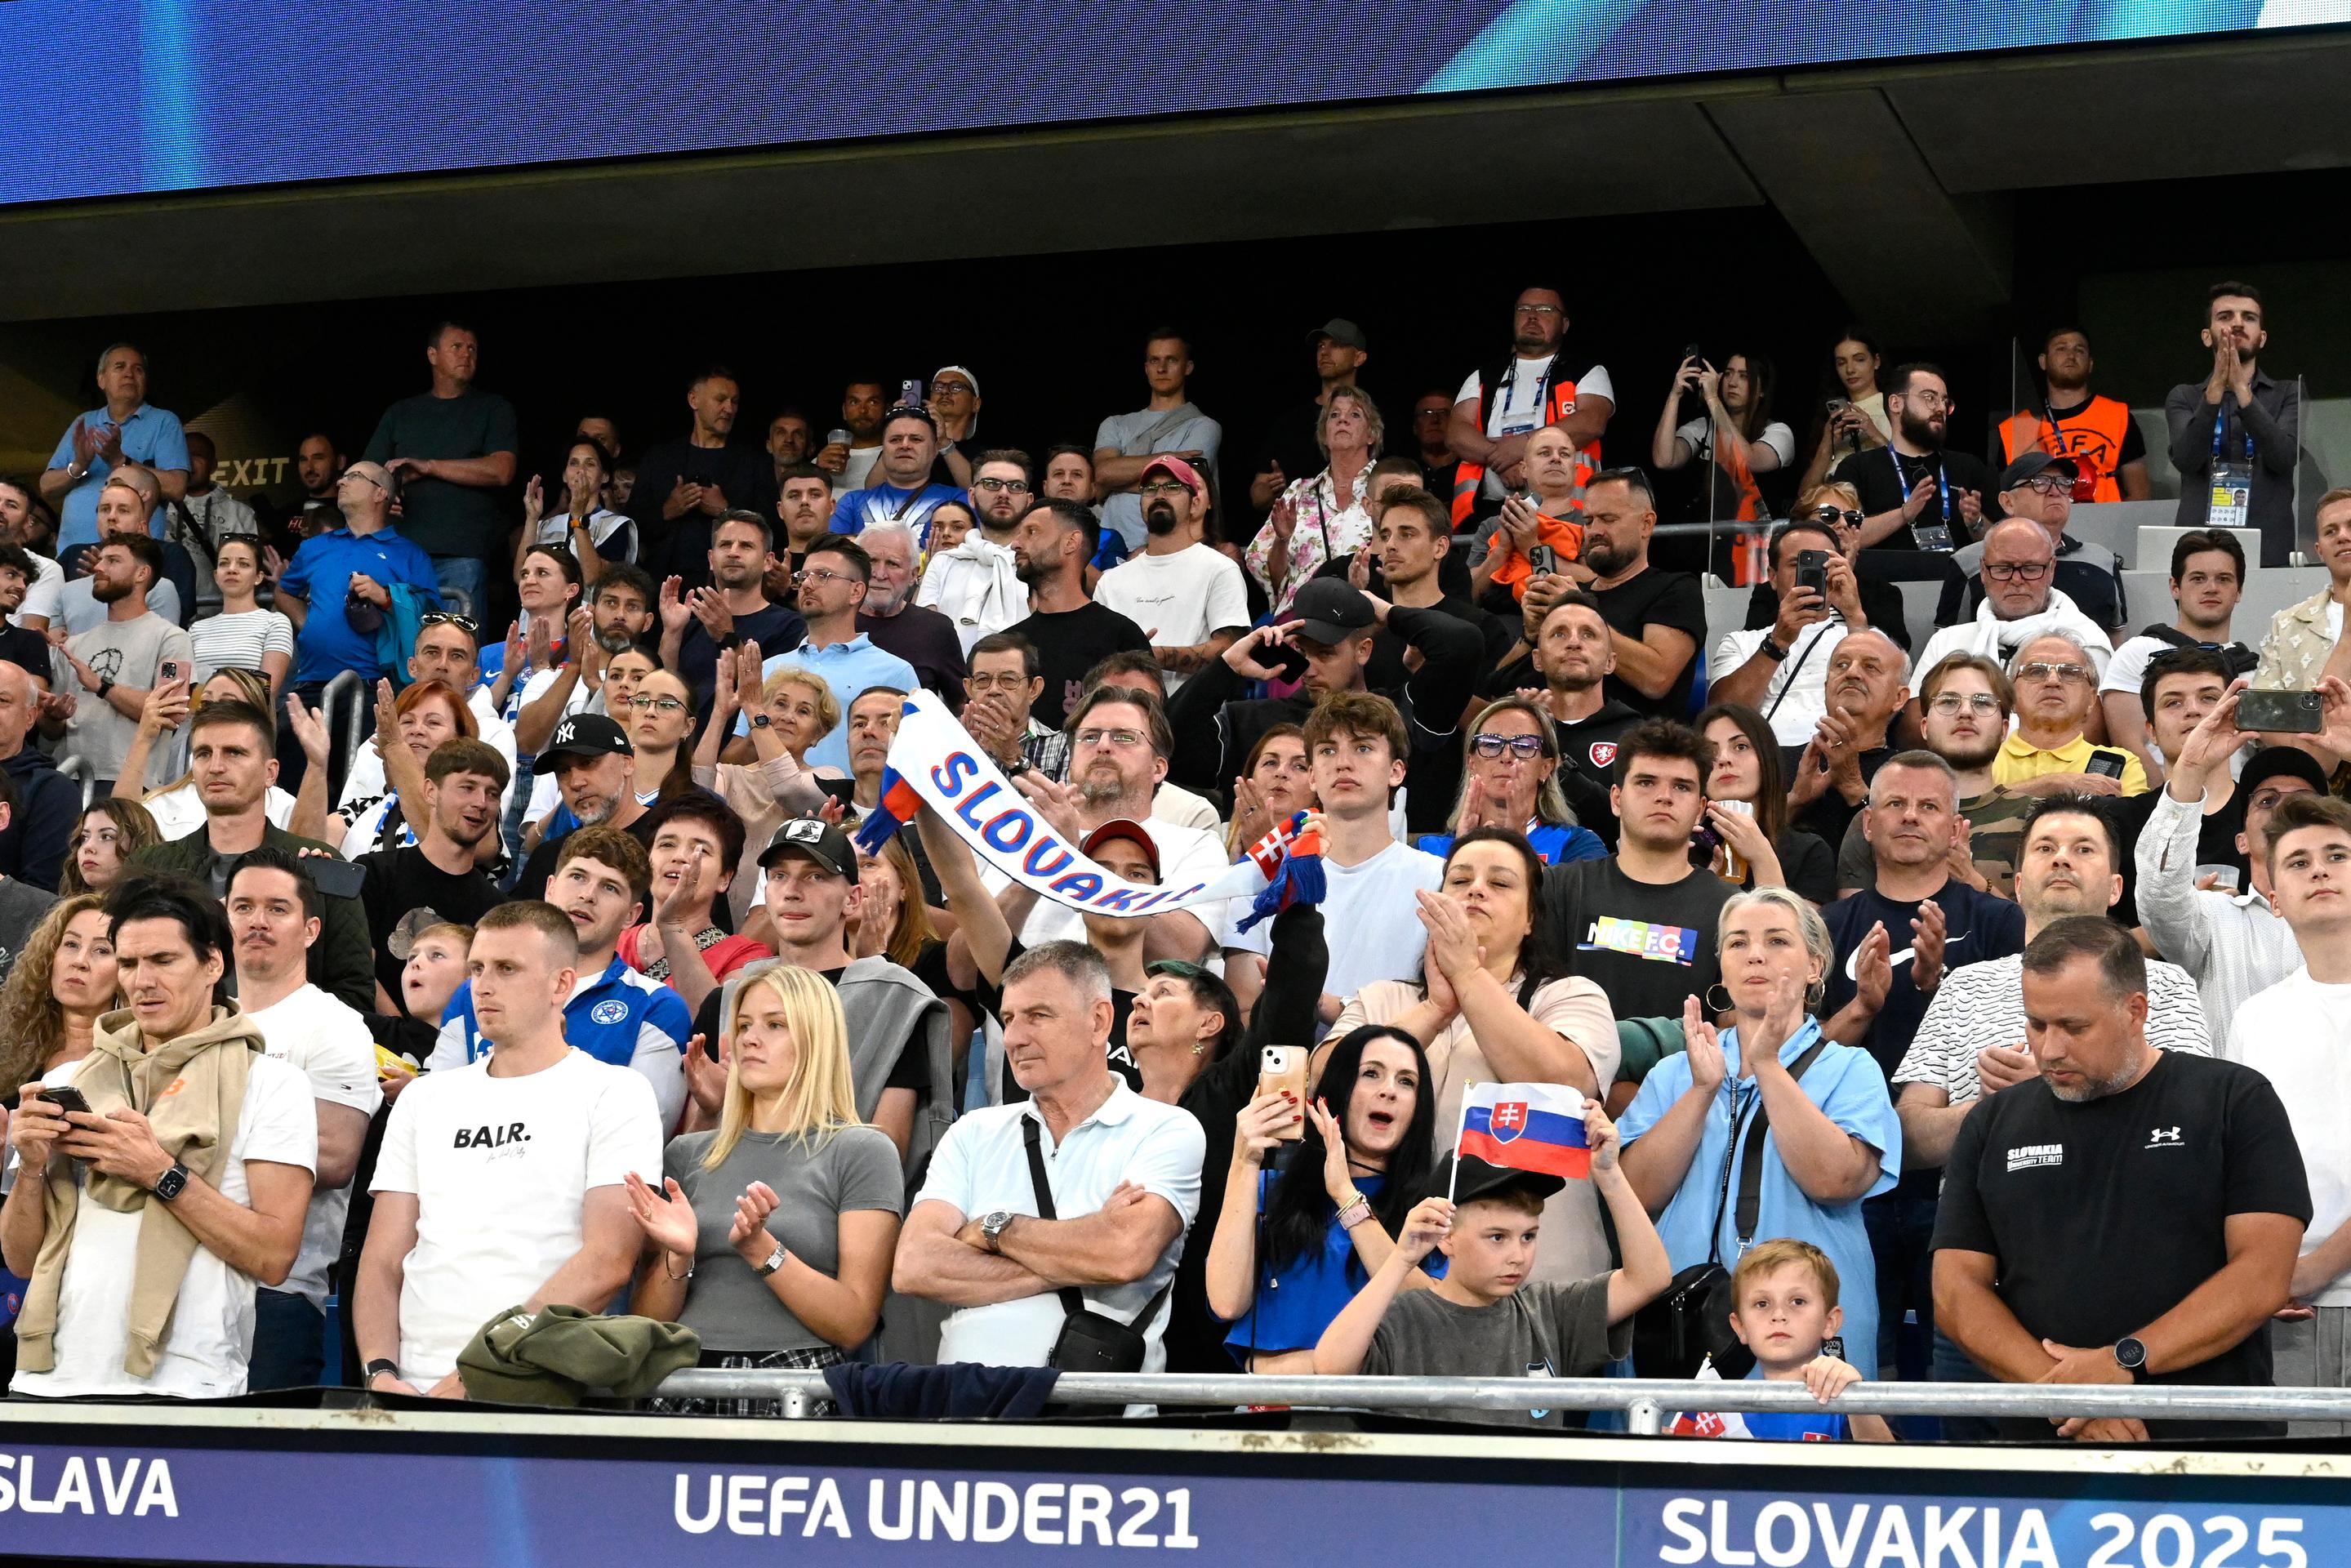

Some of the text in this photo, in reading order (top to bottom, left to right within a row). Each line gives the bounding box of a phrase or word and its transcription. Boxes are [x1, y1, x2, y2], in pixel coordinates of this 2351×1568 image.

[210, 457, 289, 488] EXIT
[1587, 922, 1685, 956] NIKE F.C.
[454, 1122, 532, 1148] BALR.
[2006, 1143, 2064, 1160] SLOVAKIA
[2037, 1154, 2063, 1164] TEAM
[675, 1474, 1199, 1548] UEFA UNDER21
[1659, 1498, 2308, 1568] SLOVAKIA 2025
